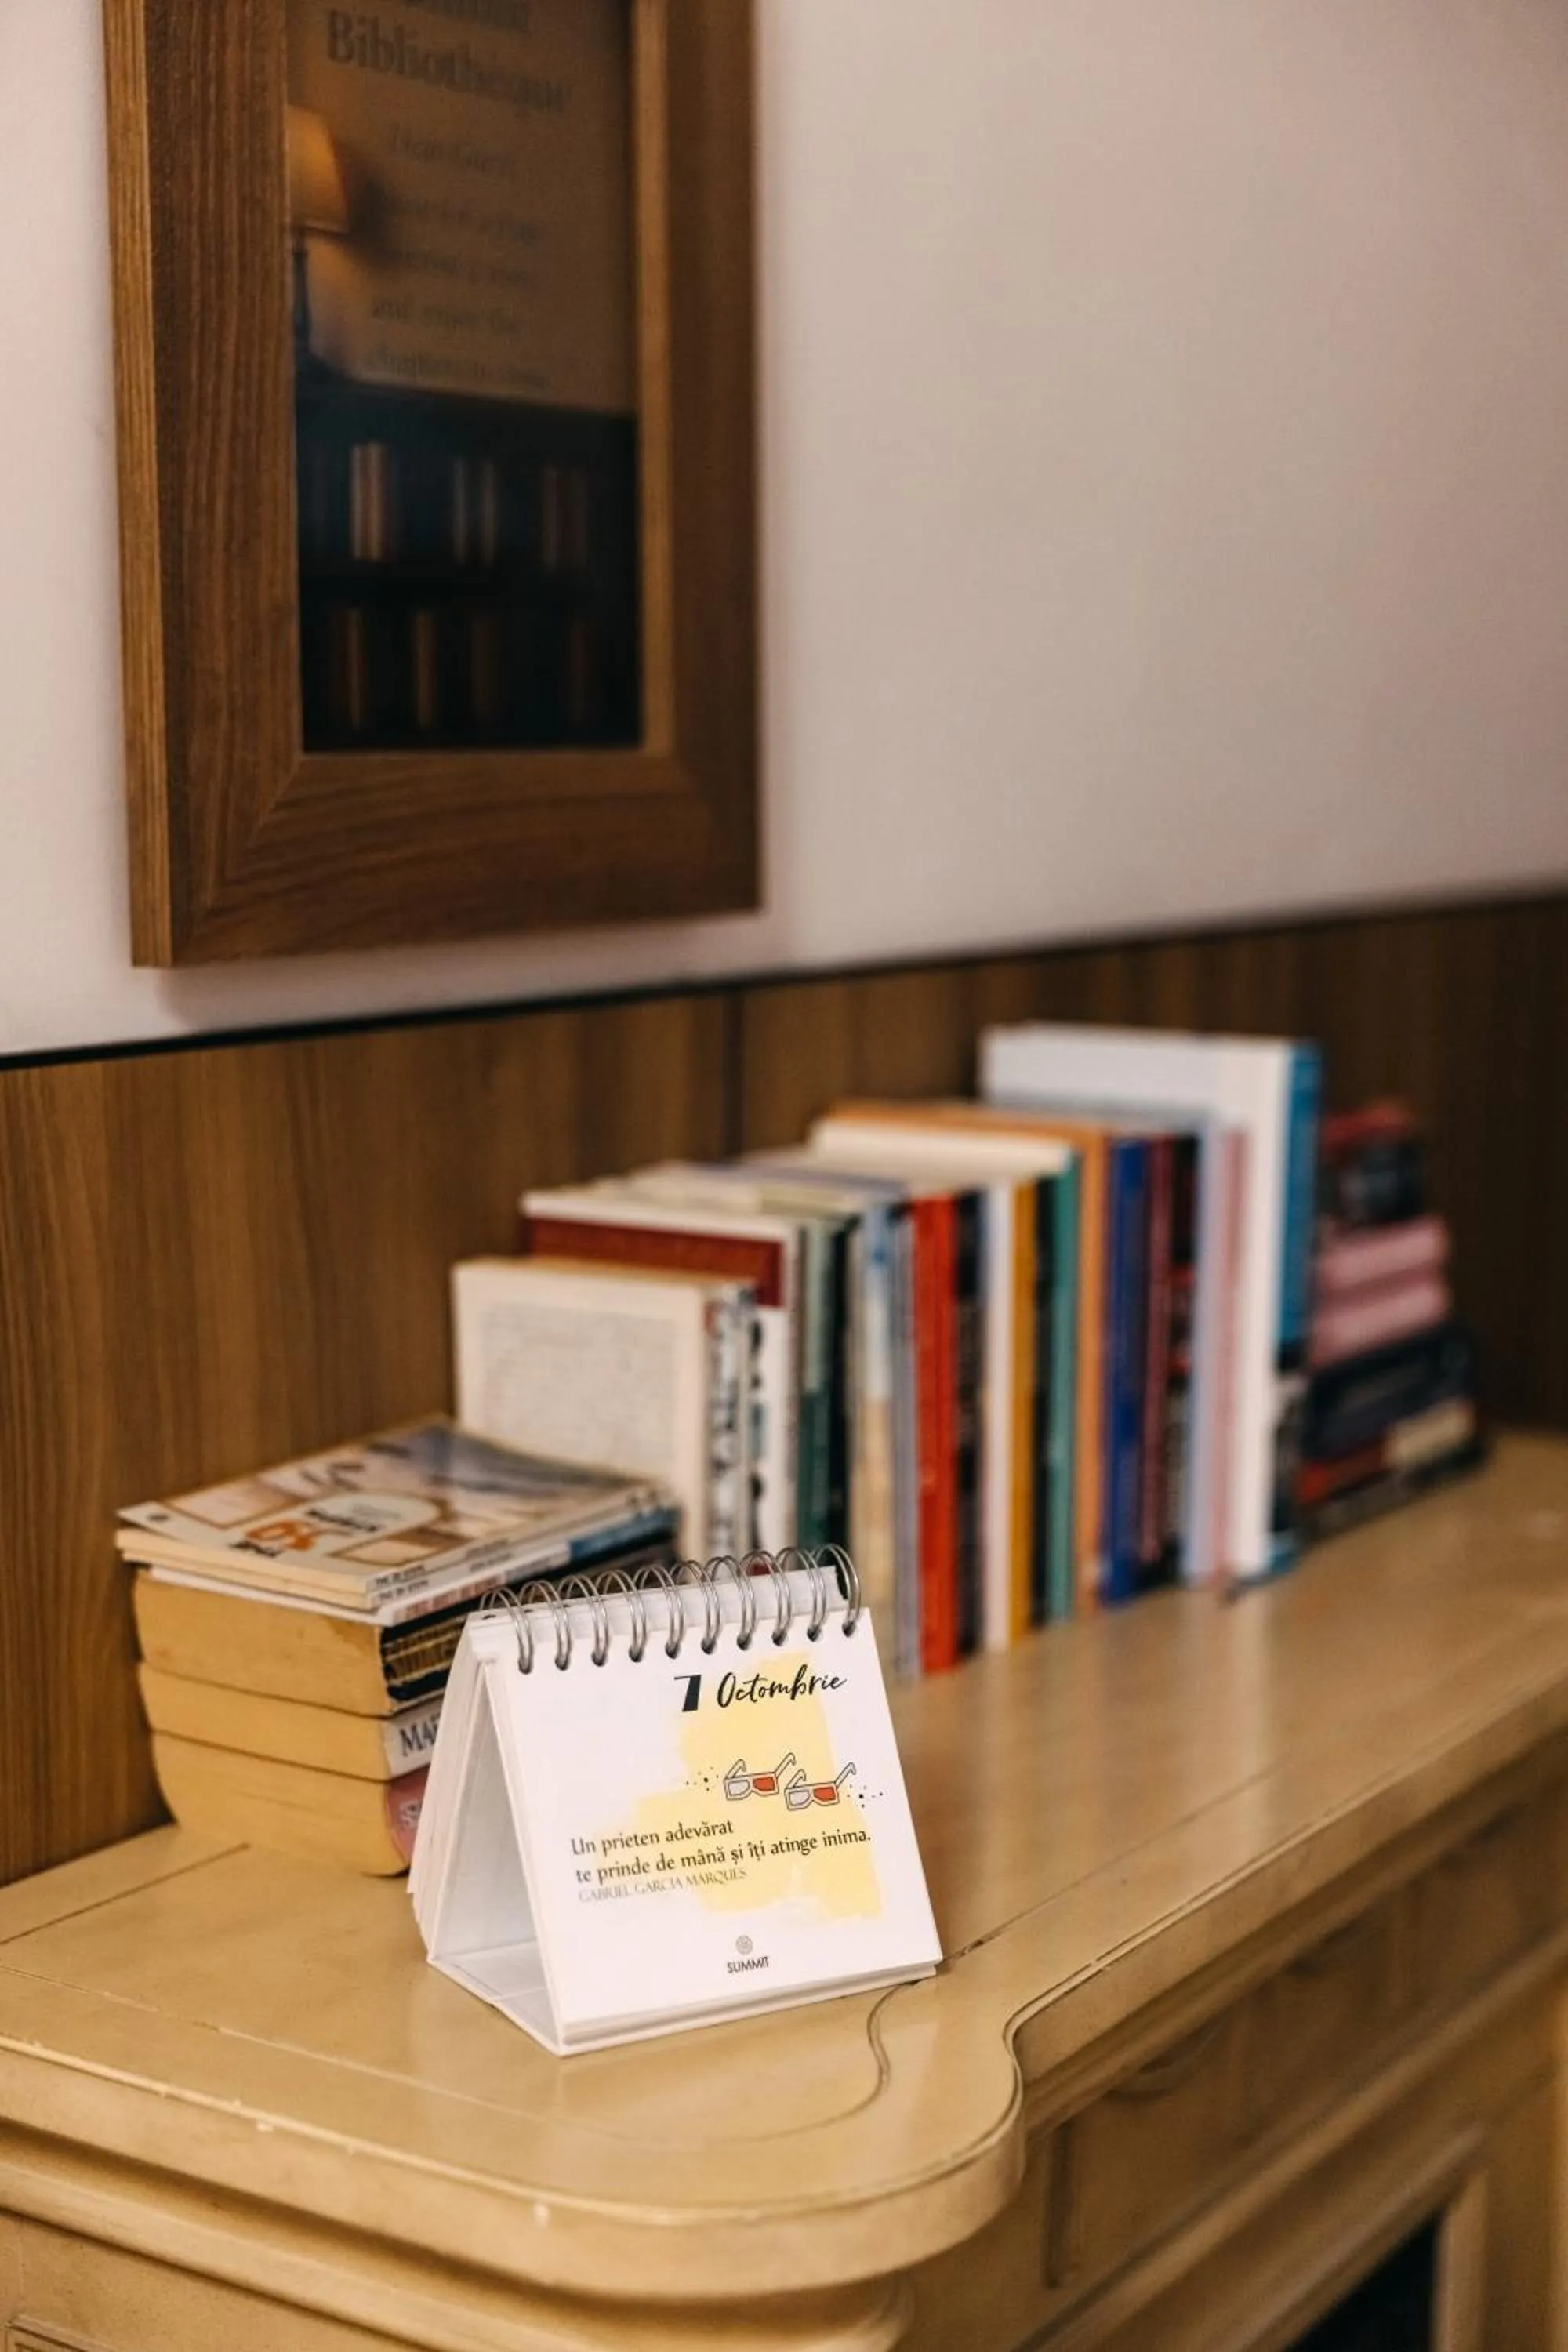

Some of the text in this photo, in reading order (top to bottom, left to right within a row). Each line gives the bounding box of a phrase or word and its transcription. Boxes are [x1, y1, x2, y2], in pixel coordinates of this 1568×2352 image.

[717, 1664, 848, 1708] Octombrie
[571, 1819, 735, 1857] Un prieten adevărat
[576, 1868, 591, 1883] te
[597, 1856, 651, 1884] prinde
[656, 1853, 676, 1871] de
[681, 1846, 726, 1868] mână
[771, 1836, 818, 1856] atinge
[822, 1829, 872, 1847] inima.
[634, 1877, 684, 1894] GARCIA
[687, 1867, 748, 1886] MARQUES
[727, 1956, 769, 1974] SUMMIT
